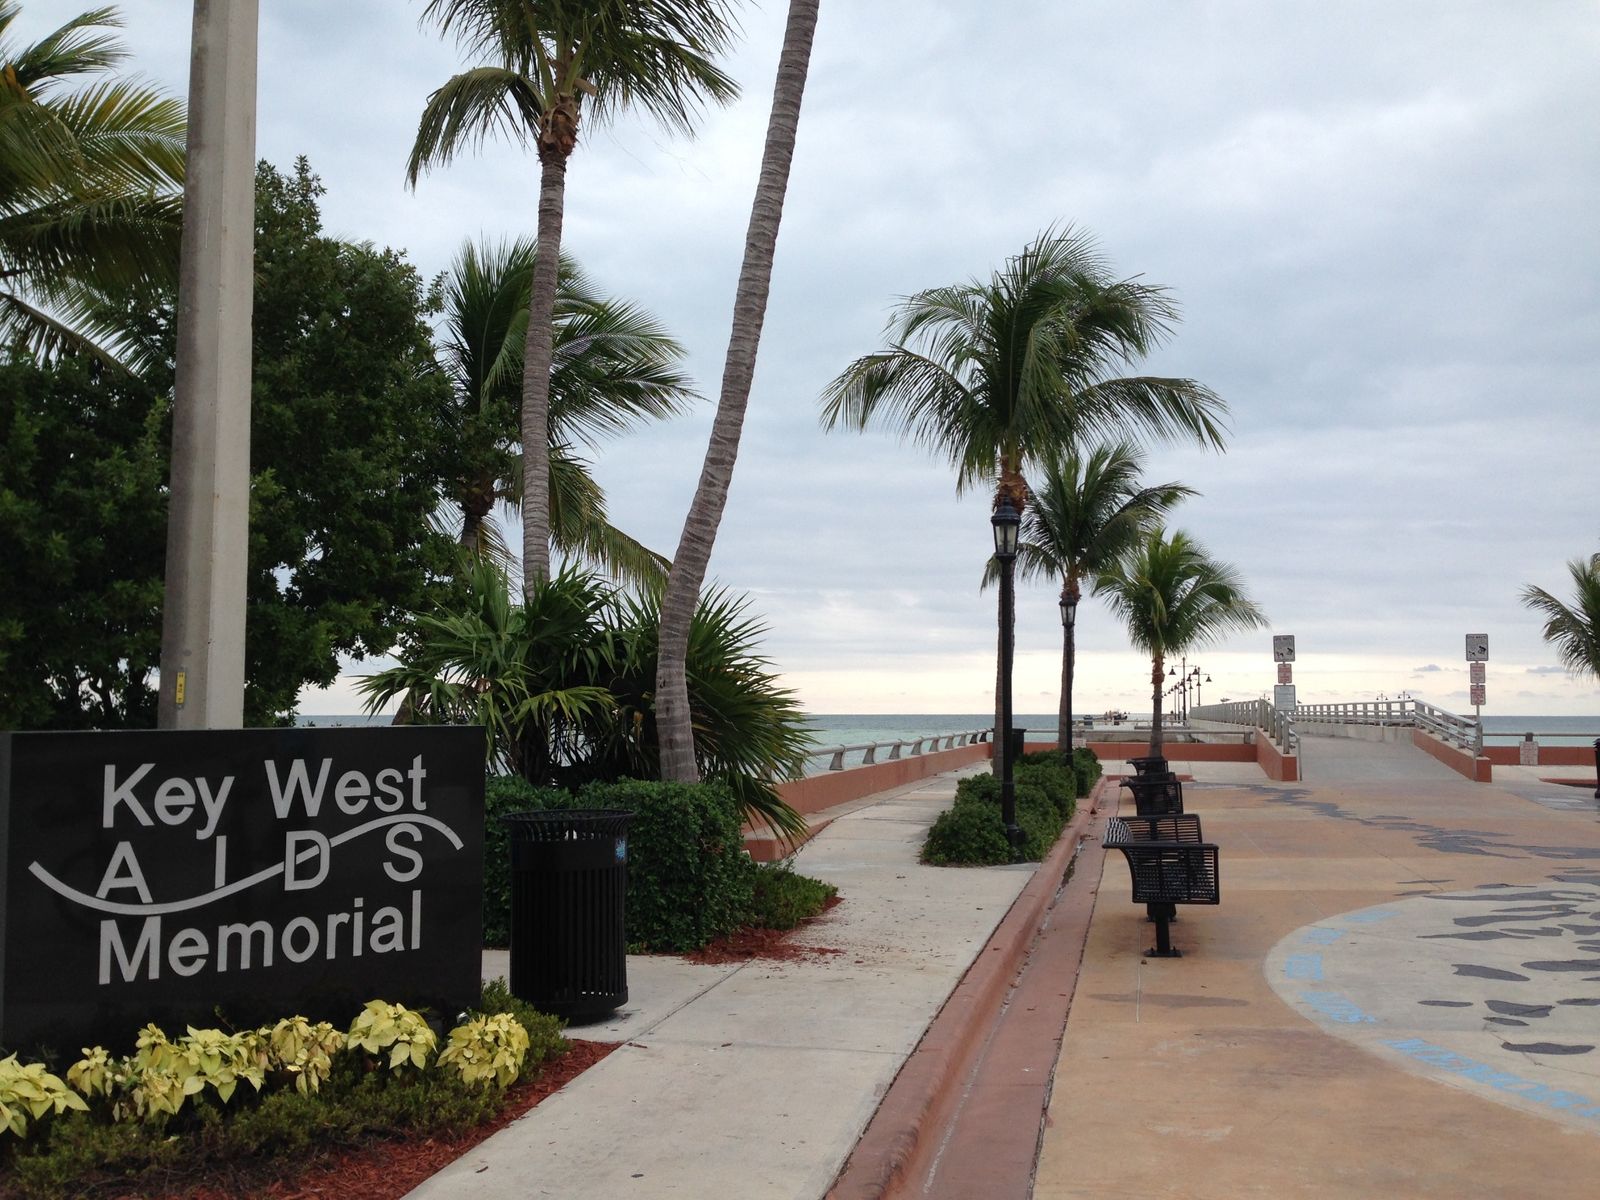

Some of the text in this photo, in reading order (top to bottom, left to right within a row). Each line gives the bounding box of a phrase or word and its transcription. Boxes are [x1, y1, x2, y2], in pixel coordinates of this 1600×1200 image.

[102, 754, 427, 840] Key West
[95, 823, 424, 904] AIDS
[99, 889, 422, 985] Memorial
